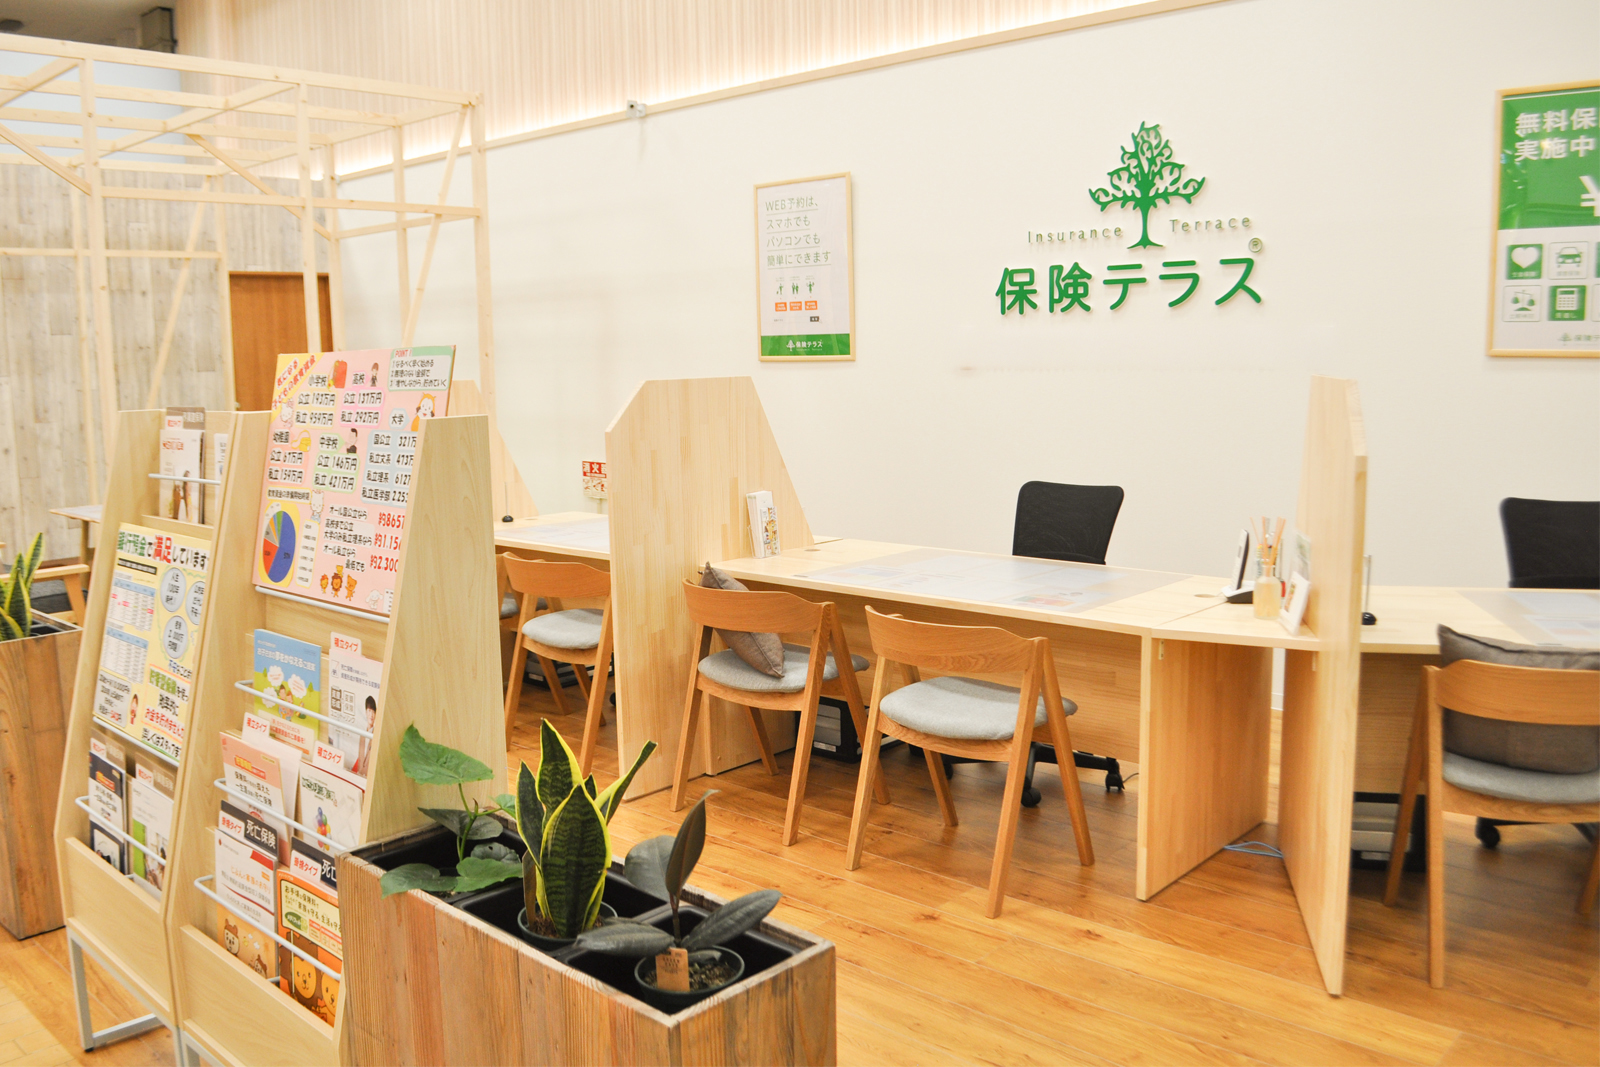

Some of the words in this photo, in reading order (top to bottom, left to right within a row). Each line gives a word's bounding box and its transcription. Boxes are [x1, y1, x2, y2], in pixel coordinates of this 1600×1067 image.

[1515, 108, 1600, 135] 無料保
[1515, 136, 1596, 162] 実施中
[765, 196, 818, 212] WEB予約は、
[766, 214, 811, 230] スマホでも
[1028, 226, 1123, 244] Insurance
[1169, 216, 1251, 233] Terrace
[766, 232, 821, 248] パソコンでも
[767, 250, 831, 267] 簡単にできます
[995, 257, 1262, 315] 保険テラス
[308, 374, 327, 387] 小学校
[353, 373, 365, 385] 高校
[298, 392, 310, 405] 公立
[312, 393, 336, 407] 193万円
[343, 392, 355, 404] 公立
[358, 392, 382, 404] 137万円
[295, 411, 308, 424] 私立
[340, 411, 353, 423] 私立
[355, 411, 379, 424] 292万円
[391, 413, 404, 425] 大学
[320, 436, 338, 450] 中学校
[270, 450, 282, 461] 公立
[317, 455, 330, 467] 公立
[332, 456, 357, 471] 146万円
[328, 475, 355, 490] 421万円
[245, 819, 276, 849] 死亡保険
